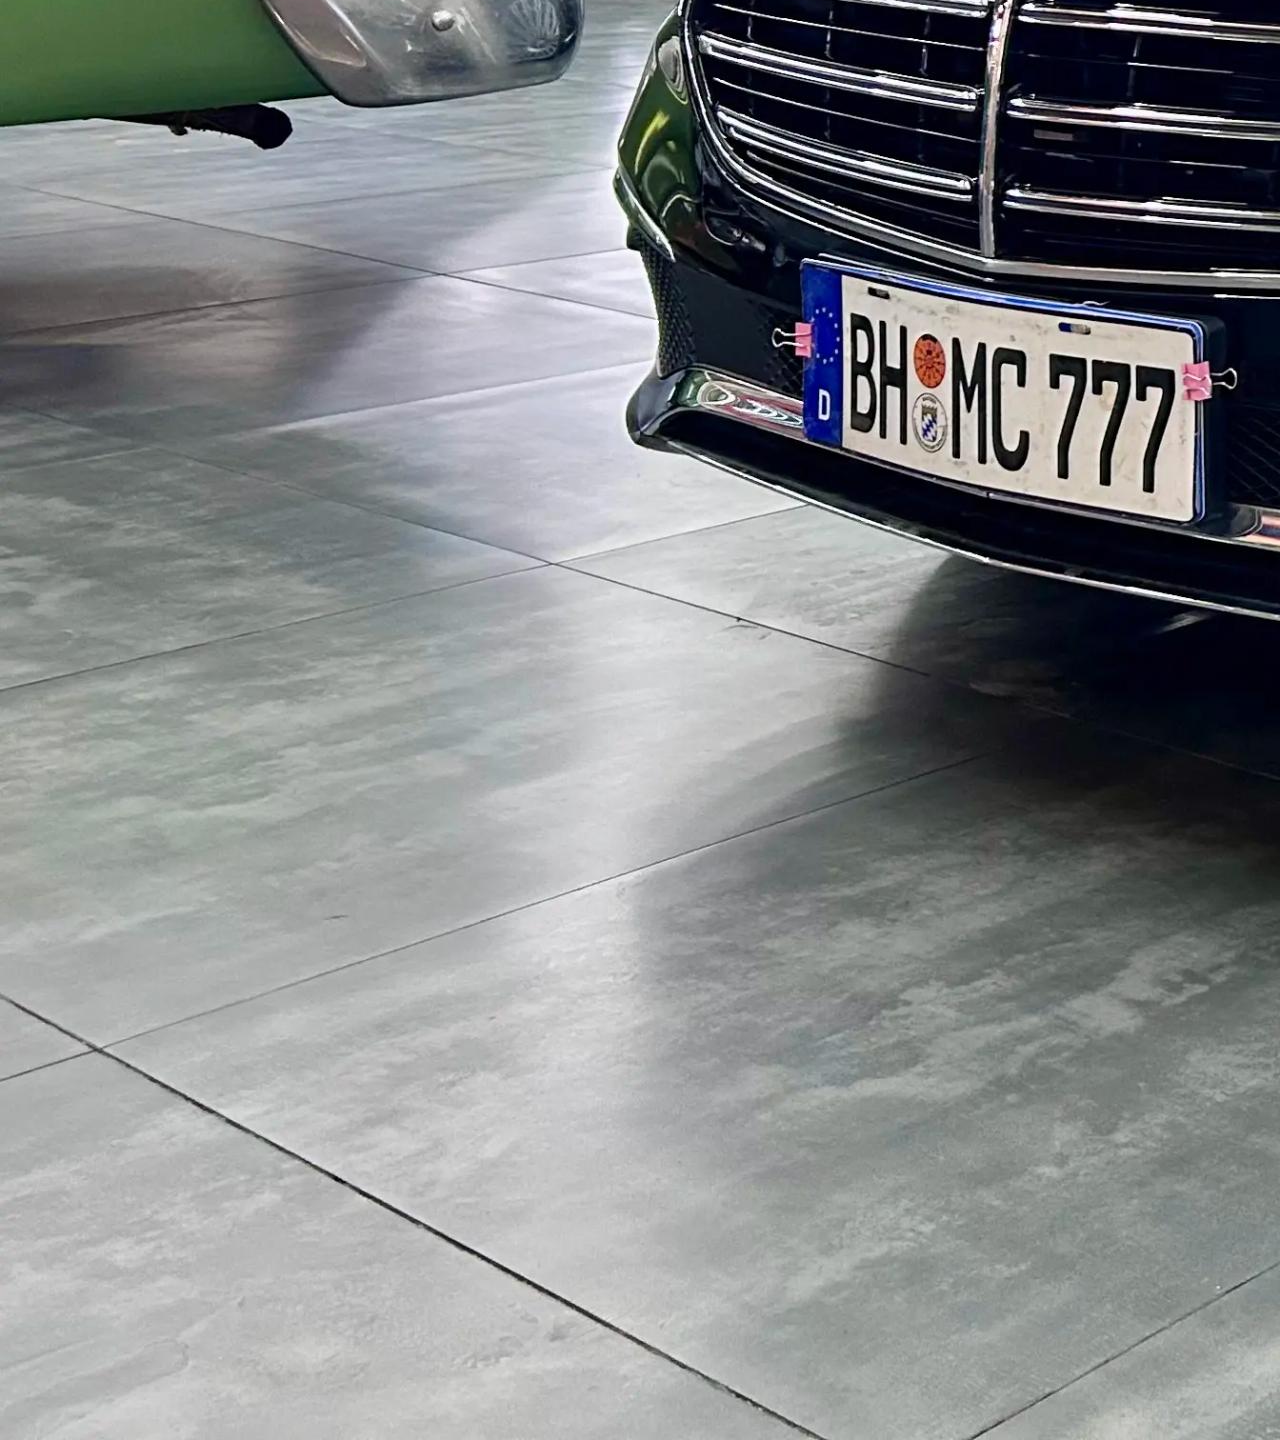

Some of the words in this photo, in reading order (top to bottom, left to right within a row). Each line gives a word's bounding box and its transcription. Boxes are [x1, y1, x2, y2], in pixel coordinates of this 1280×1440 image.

[819, 389, 830, 421] D
[850, 312, 907, 445] BH
[952, 337, 1030, 471] MC
[1049, 353, 1176, 494] 777
